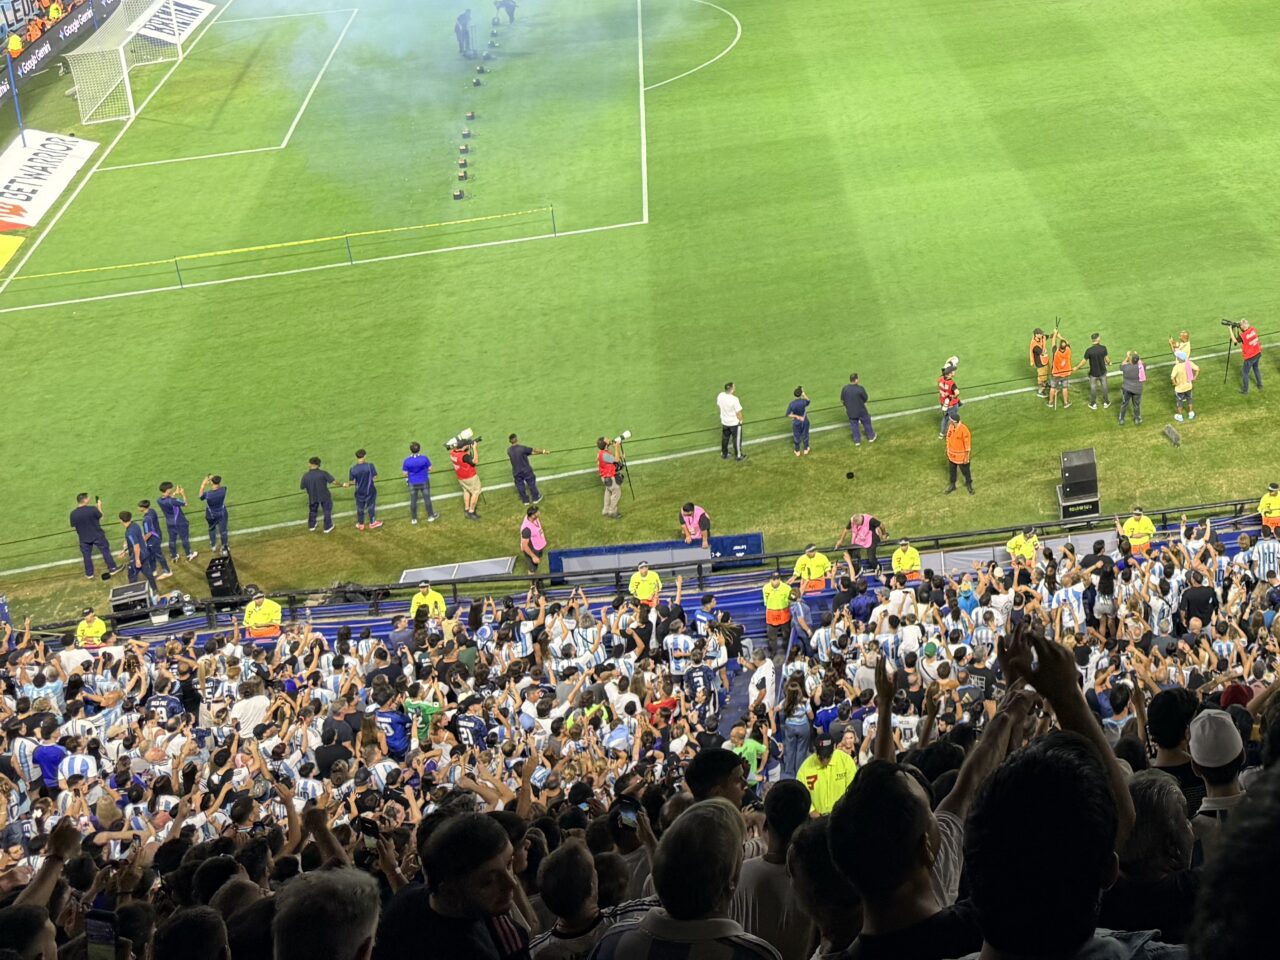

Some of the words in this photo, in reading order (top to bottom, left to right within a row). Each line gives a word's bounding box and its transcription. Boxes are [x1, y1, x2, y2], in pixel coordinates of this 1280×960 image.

[63, 18, 80, 37] Google
[78, 6, 94, 27] Gemini
[22, 54, 37, 74] Google
[35, 41, 51, 61] Gemini
[0, 135, 79, 202] BETWARRIOR
